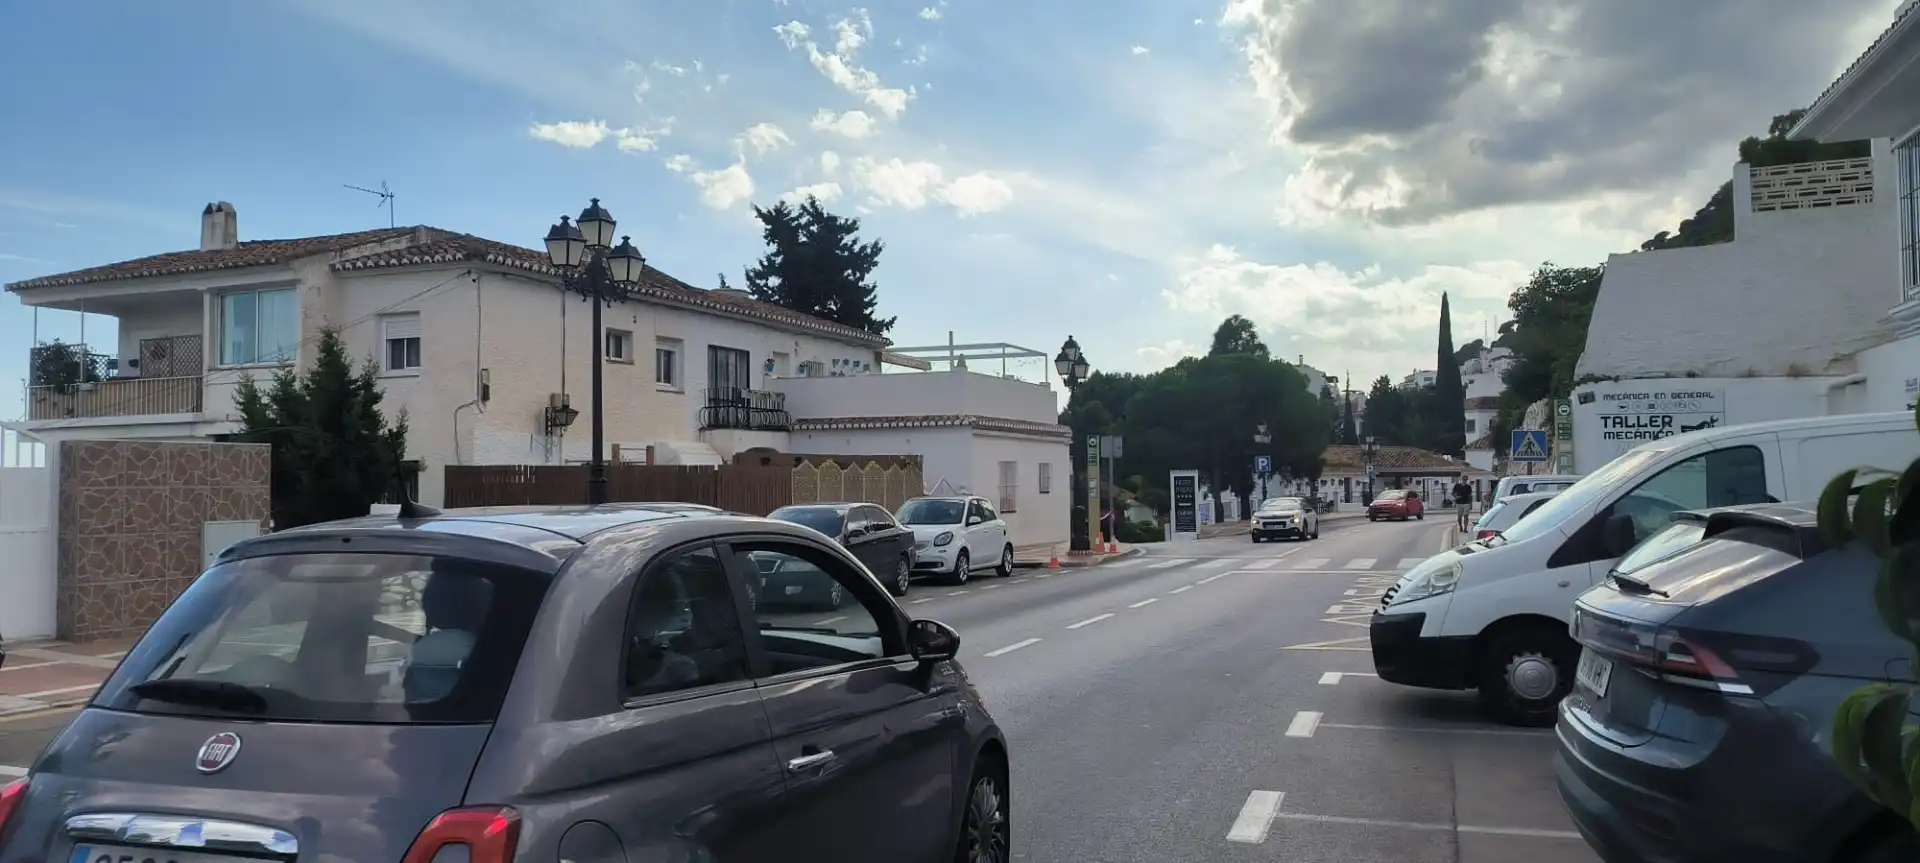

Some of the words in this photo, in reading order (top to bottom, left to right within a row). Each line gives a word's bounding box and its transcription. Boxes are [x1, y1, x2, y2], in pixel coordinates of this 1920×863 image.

[1654, 392, 1667, 400] EN
[1671, 391, 1714, 400] GENERAL
[1600, 415, 1673, 428] TALLER
[1259, 458, 1268, 471] P
[203, 743, 232, 761] FIAT
